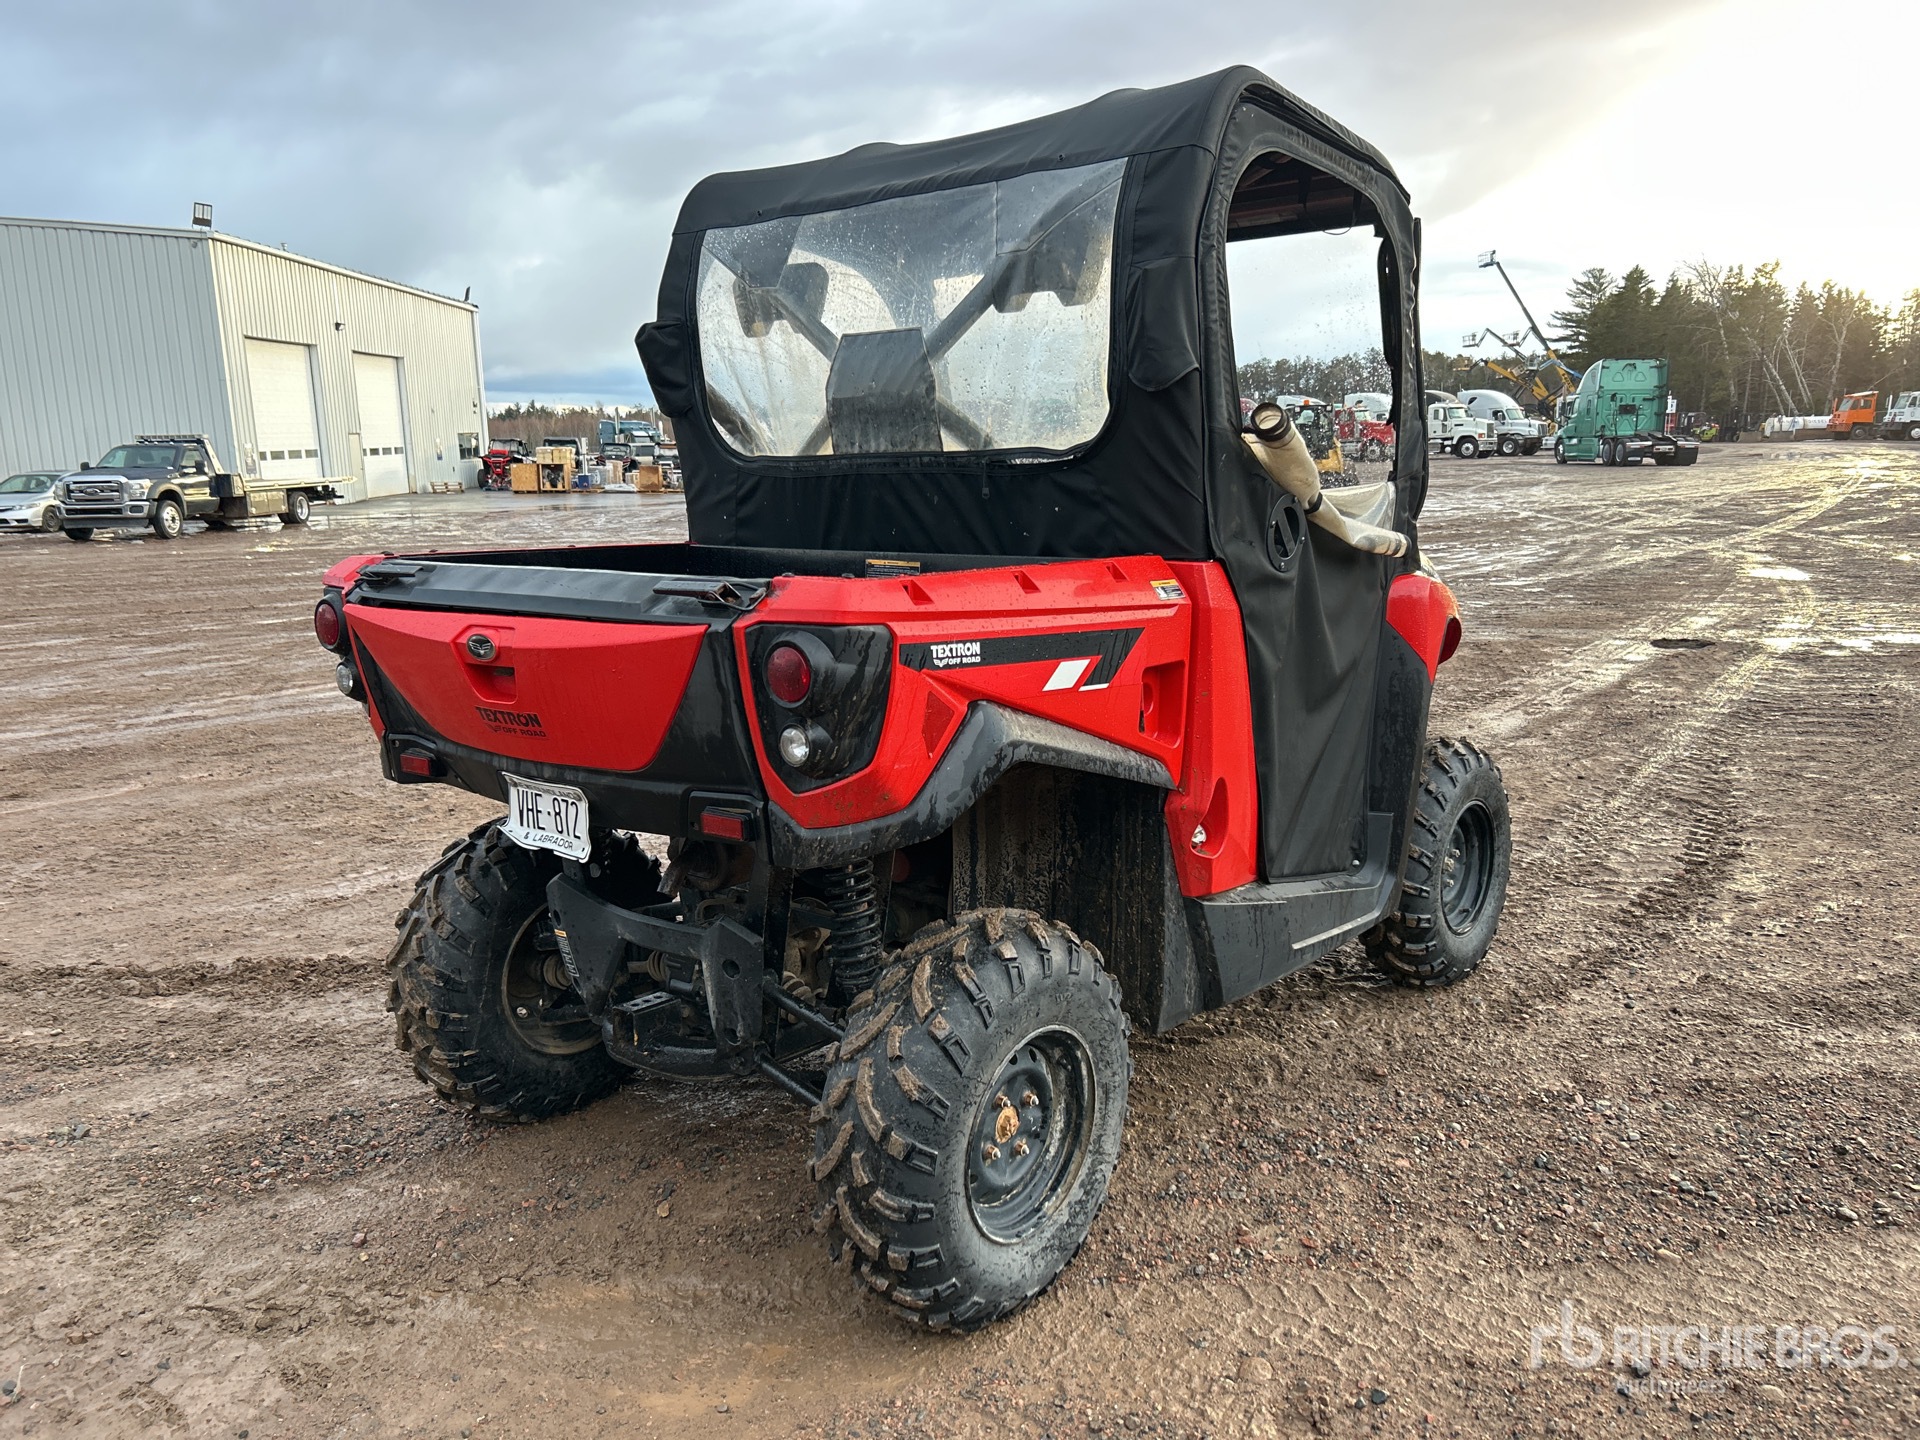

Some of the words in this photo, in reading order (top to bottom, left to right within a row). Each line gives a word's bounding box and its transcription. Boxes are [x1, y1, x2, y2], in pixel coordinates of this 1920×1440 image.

[931, 642, 980, 658] TEXTRON
[475, 707, 542, 728] TEXTRON
[520, 729, 546, 737] ROAD
[524, 832, 530, 840] &
[533, 834, 574, 851] LABRADOR
